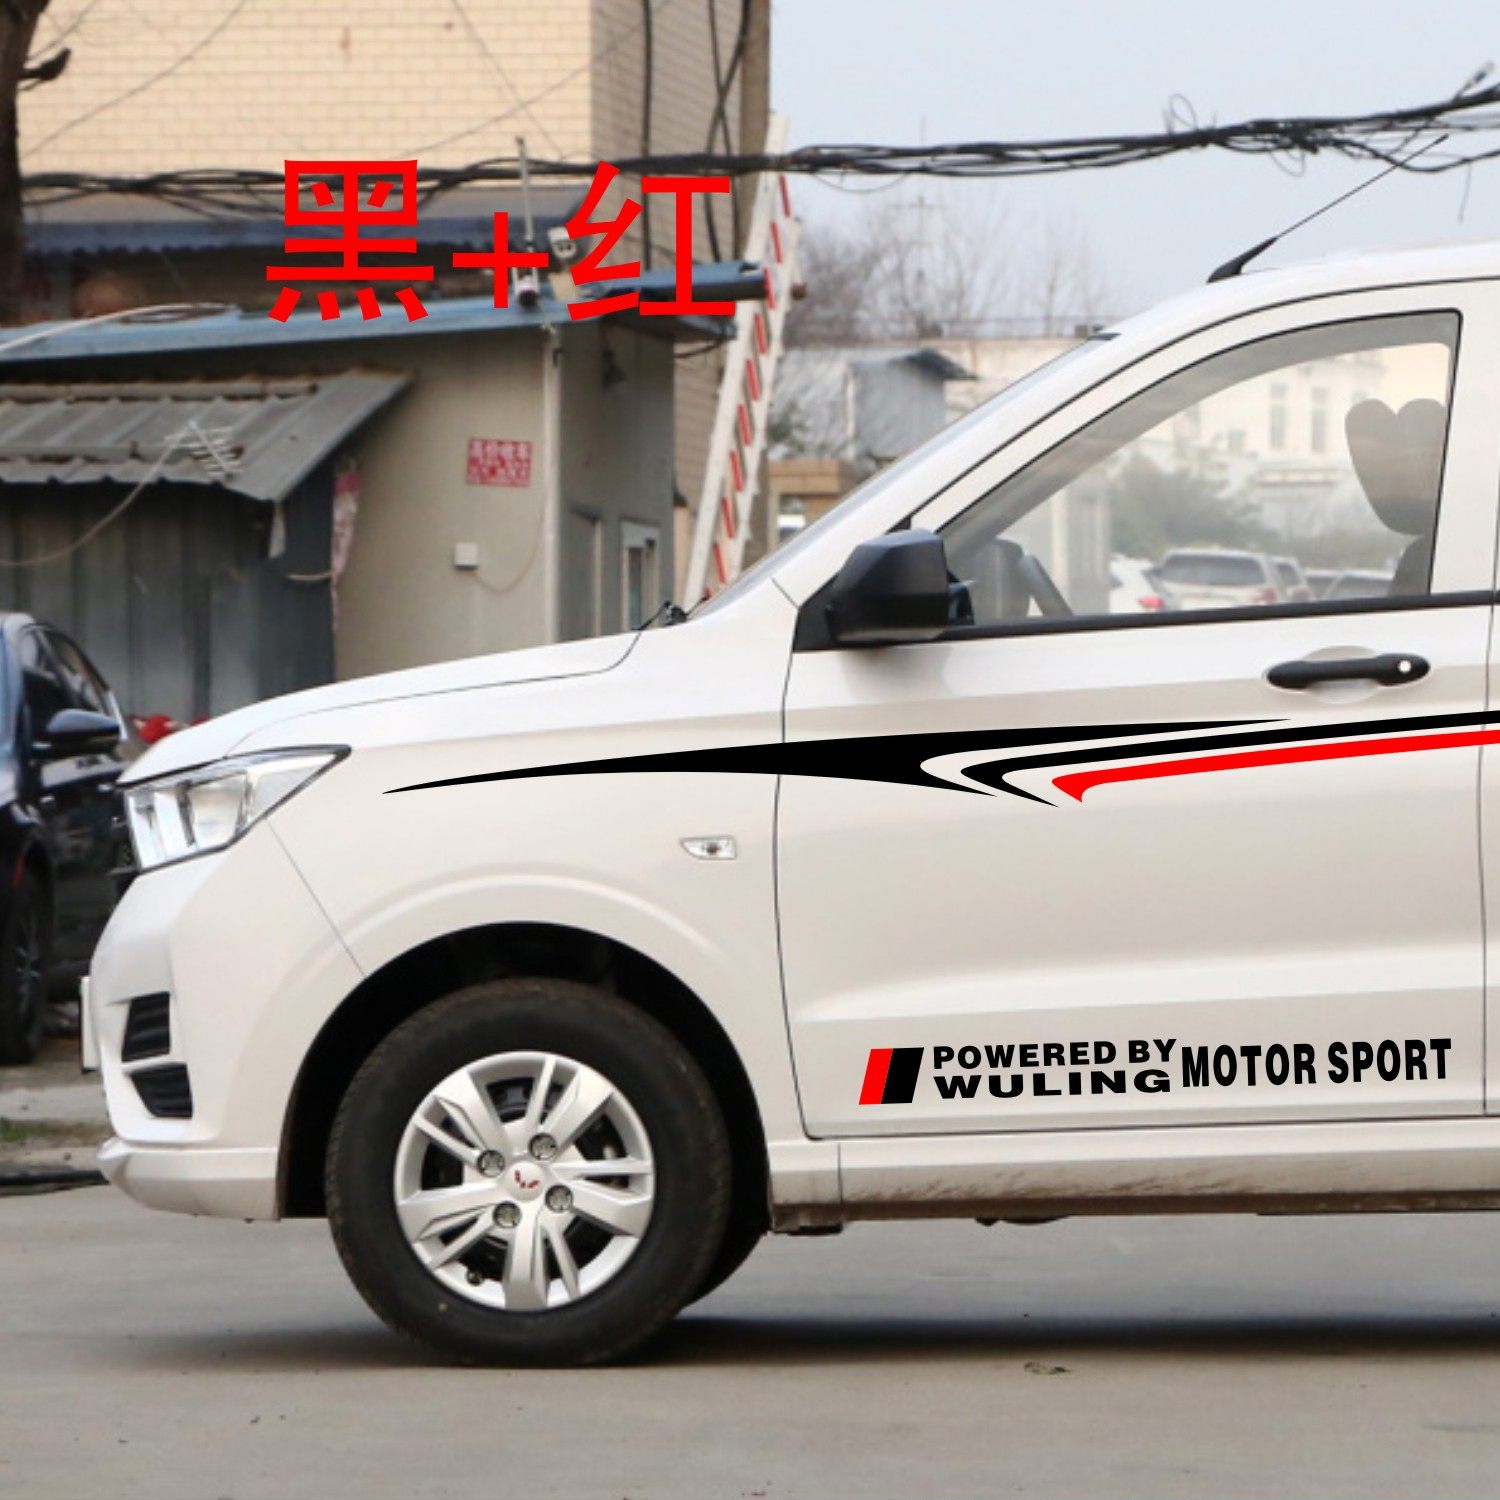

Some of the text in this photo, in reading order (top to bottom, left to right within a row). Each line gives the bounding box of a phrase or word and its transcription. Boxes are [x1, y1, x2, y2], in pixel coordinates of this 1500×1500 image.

[933, 1037, 1178, 1071] POWERED BY
[1181, 1037, 1453, 1089] MOTOR SPORT
[933, 1067, 1173, 1101] WULING
